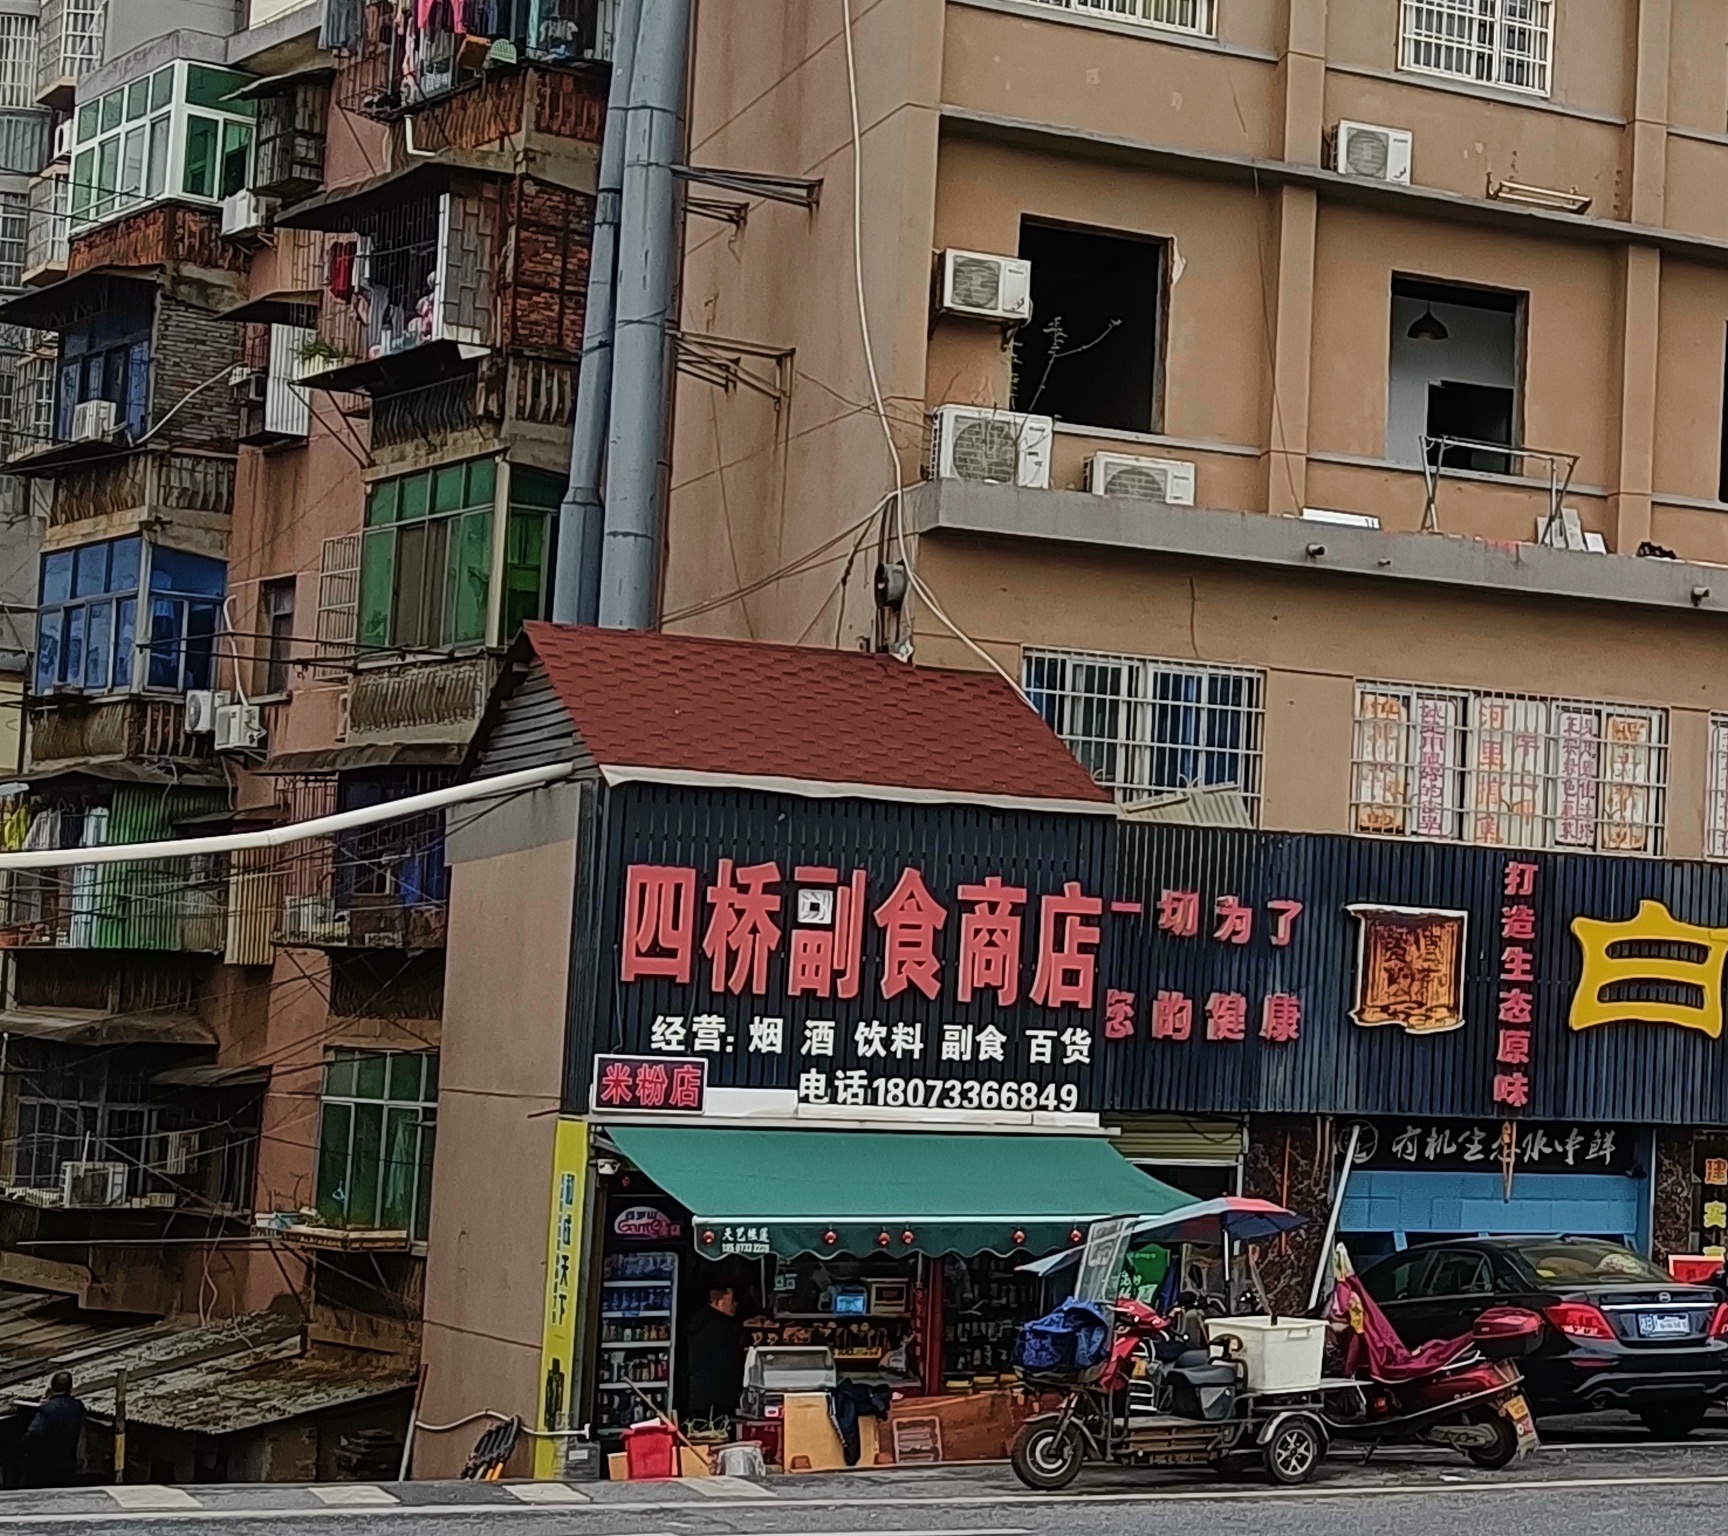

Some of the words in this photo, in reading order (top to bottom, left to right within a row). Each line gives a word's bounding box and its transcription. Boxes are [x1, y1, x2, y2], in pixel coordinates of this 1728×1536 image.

[620, 858, 1102, 1009] 四桥副食商店
[1110, 888, 1304, 947] 一切为了
[1493, 861, 1539, 1107] 打造生态原味
[748, 1016, 784, 1055] 烟
[800, 1020, 836, 1056] 酒
[854, 1021, 924, 1060] 饮料
[940, 1024, 1008, 1062] 副食
[1026, 1027, 1092, 1064] 百货
[600, 1062, 701, 1108] 米粉店
